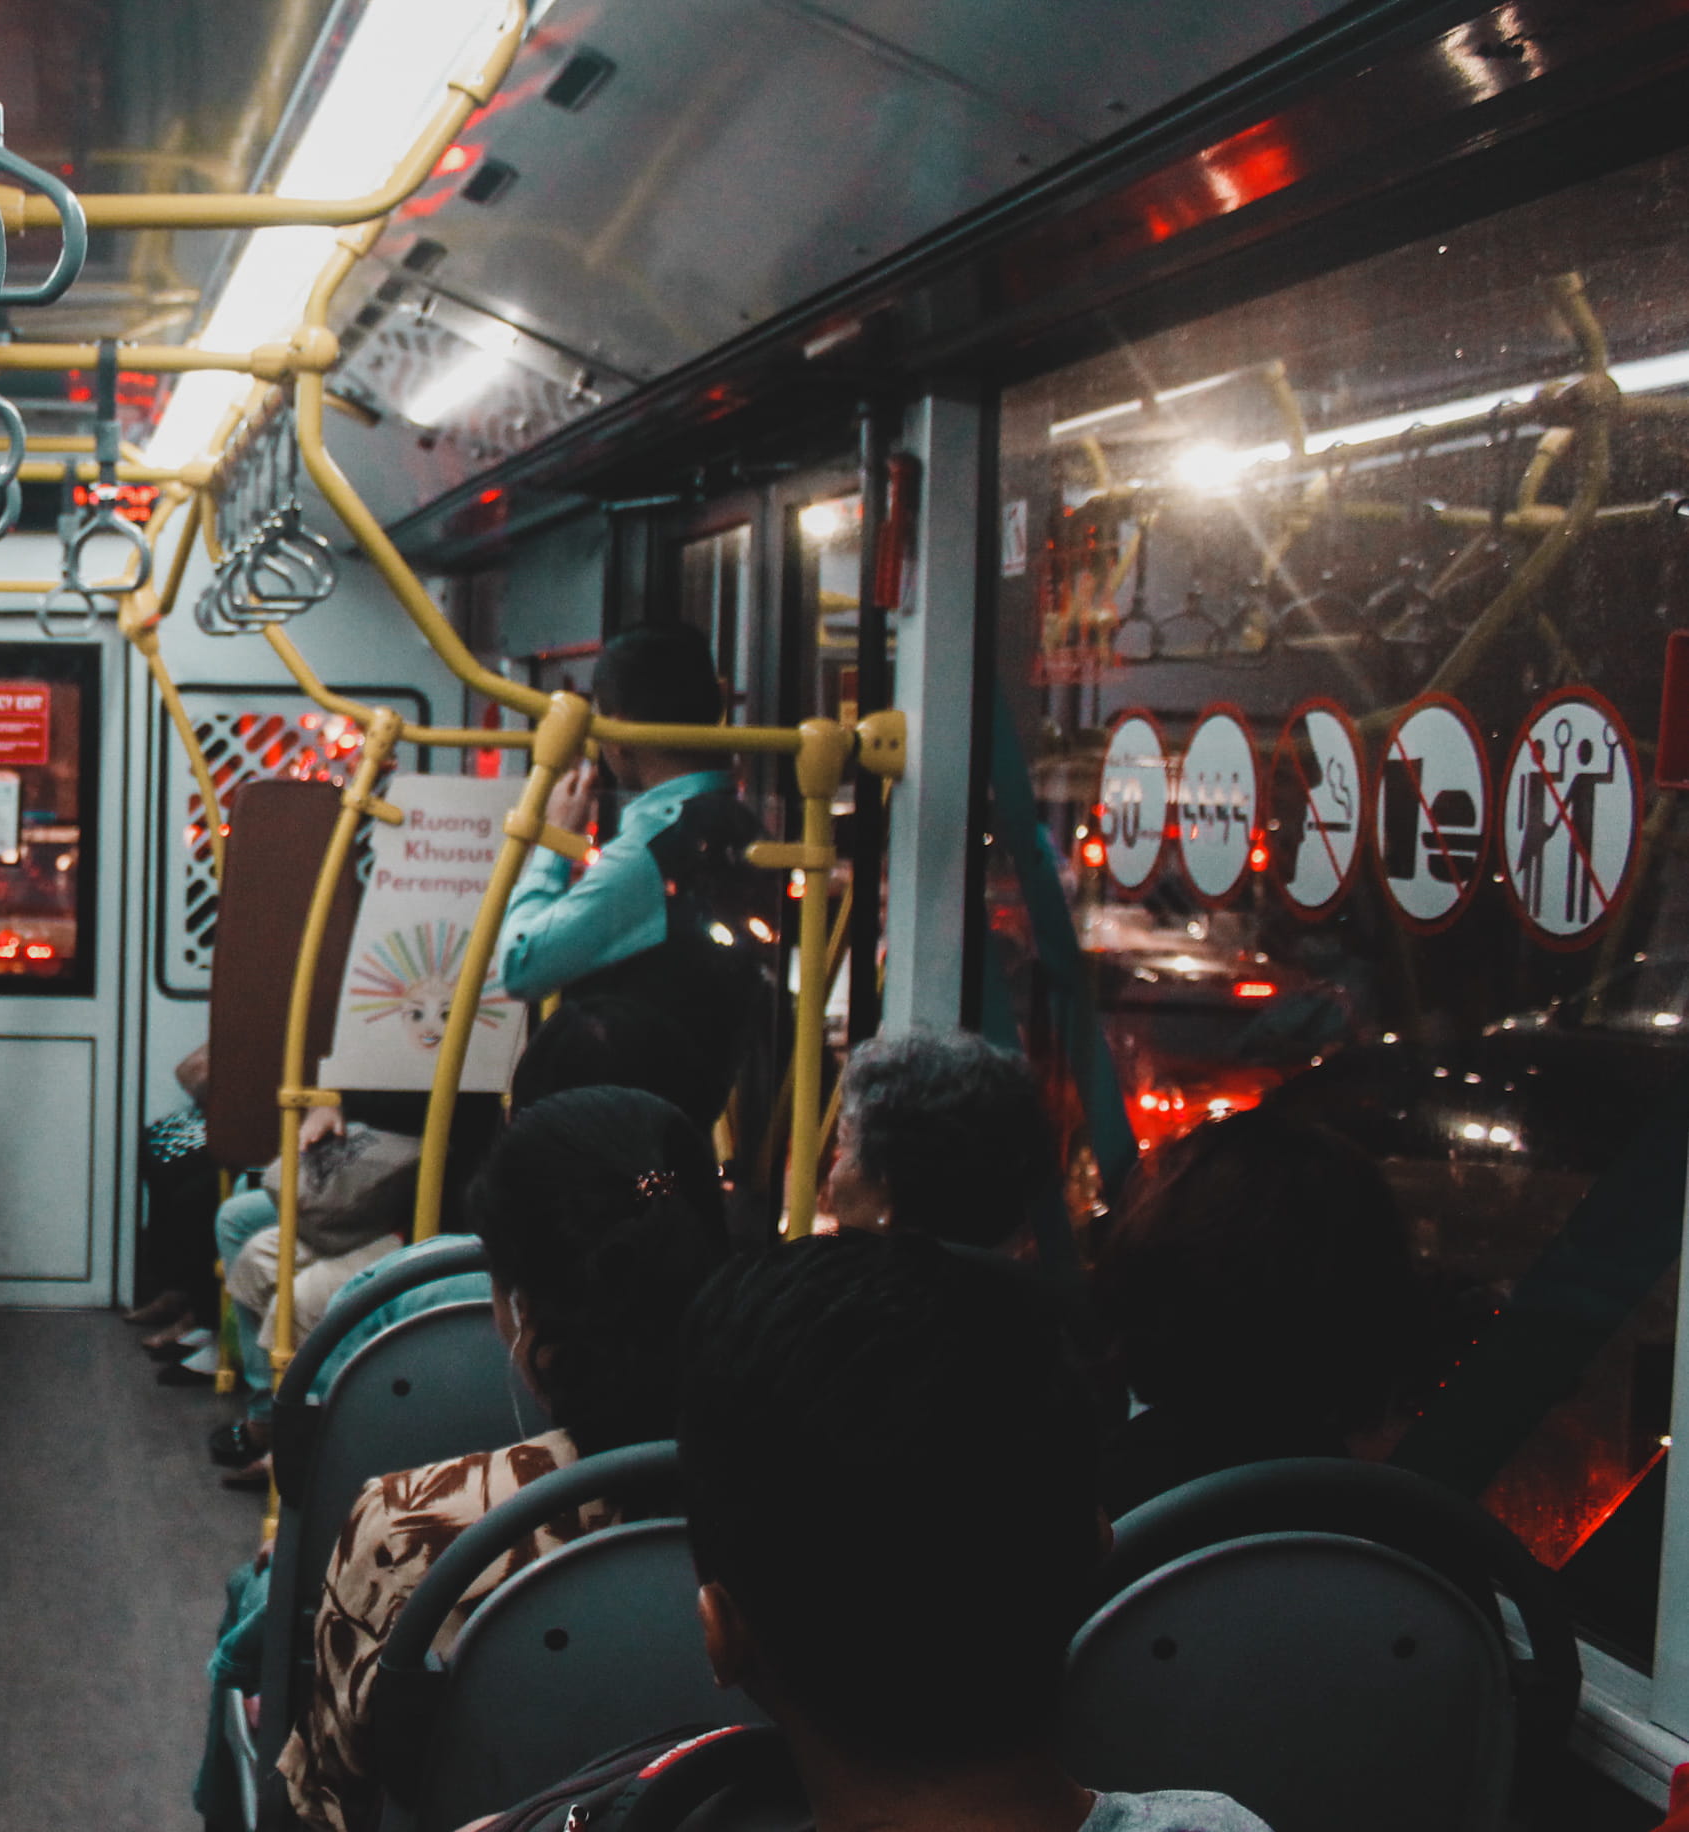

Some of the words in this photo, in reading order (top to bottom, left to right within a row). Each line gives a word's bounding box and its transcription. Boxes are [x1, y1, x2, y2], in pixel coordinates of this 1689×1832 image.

[15, 695, 43, 712] EXIT
[410, 809, 492, 838] Ruang
[405, 839, 496, 863] Khusus
[376, 869, 490, 897] Perempu
